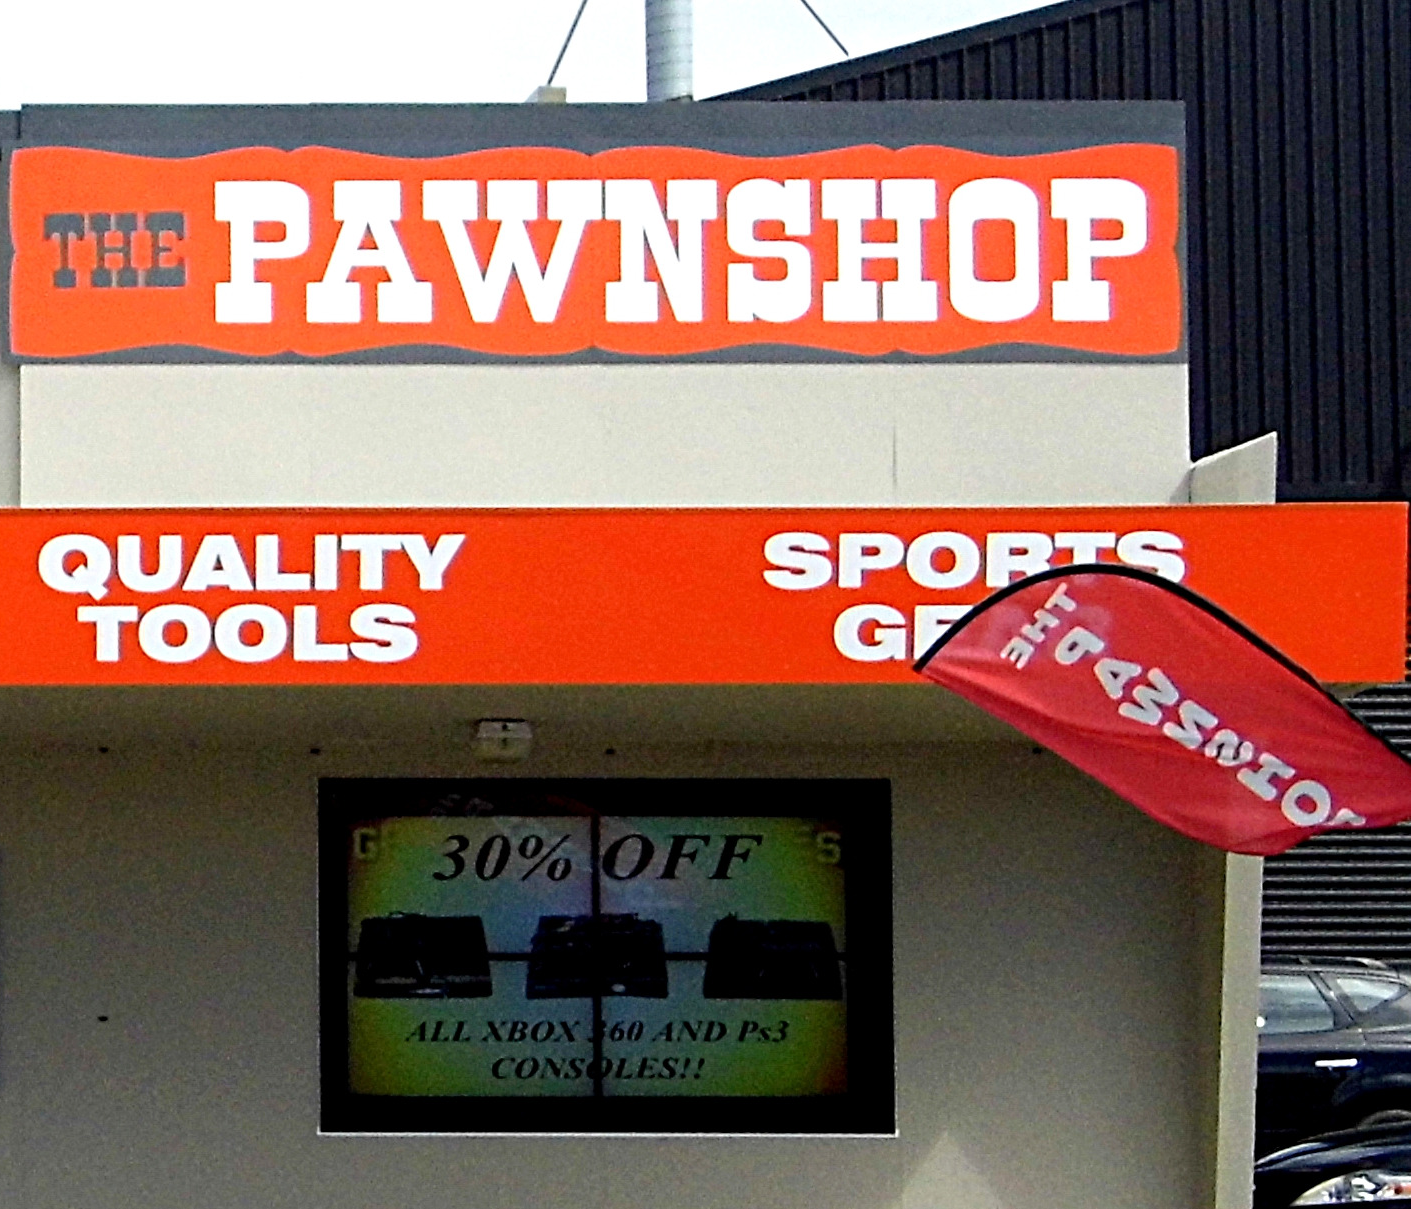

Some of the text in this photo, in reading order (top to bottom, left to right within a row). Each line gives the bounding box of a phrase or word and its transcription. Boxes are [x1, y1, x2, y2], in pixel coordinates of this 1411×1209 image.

[43, 178, 1148, 323] THE PAWNSHOP
[38, 534, 465, 601] QUALITY
[78, 604, 418, 663] TOOLS
[432, 833, 574, 881] 30%
[601, 833, 764, 881] OFF
[405, 1019, 471, 1044] ALL
[482, 1019, 580, 1044] XBOX
[652, 1019, 727, 1043] AND
[737, 1019, 791, 1044] Ps3
[491, 1056, 707, 1080] CONSOLES!!
